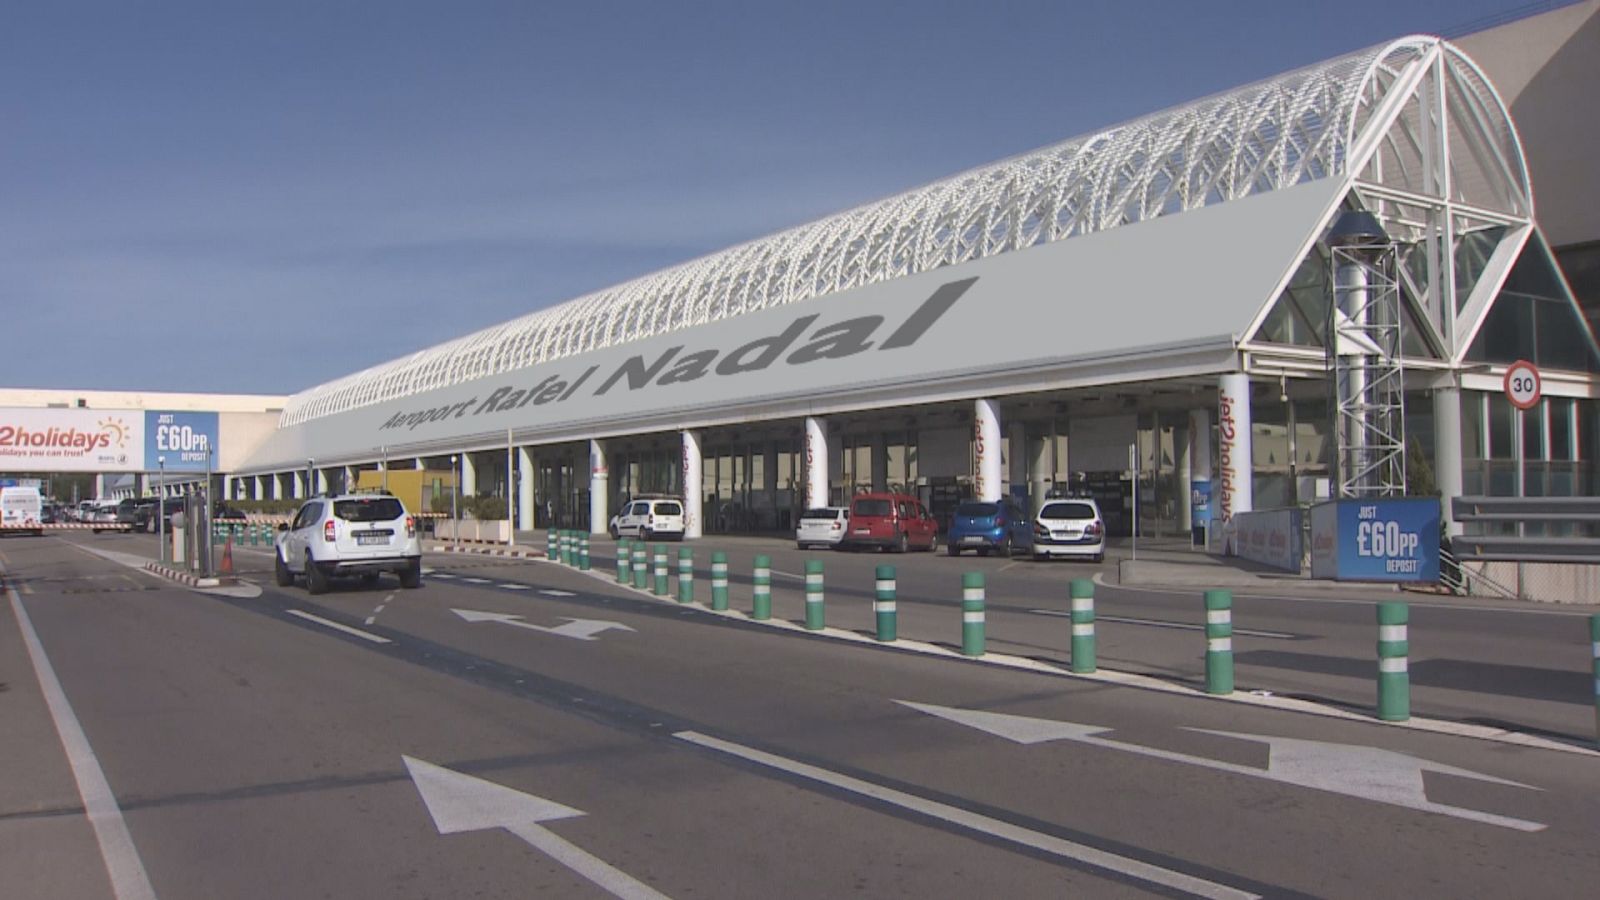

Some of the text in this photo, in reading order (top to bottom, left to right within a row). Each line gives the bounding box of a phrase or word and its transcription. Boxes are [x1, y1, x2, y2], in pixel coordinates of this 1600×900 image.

[379, 276, 980, 430] Aeroport Rafel Nadal
[1513, 377, 1533, 393] 30
[158, 414, 174, 424] JUST
[29, 450, 45, 459] you
[63, 449, 84, 457] trust
[181, 453, 206, 462] DEPOSIT
[1358, 506, 1376, 519] JUST
[1386, 560, 1416, 572] DEPOSIT
